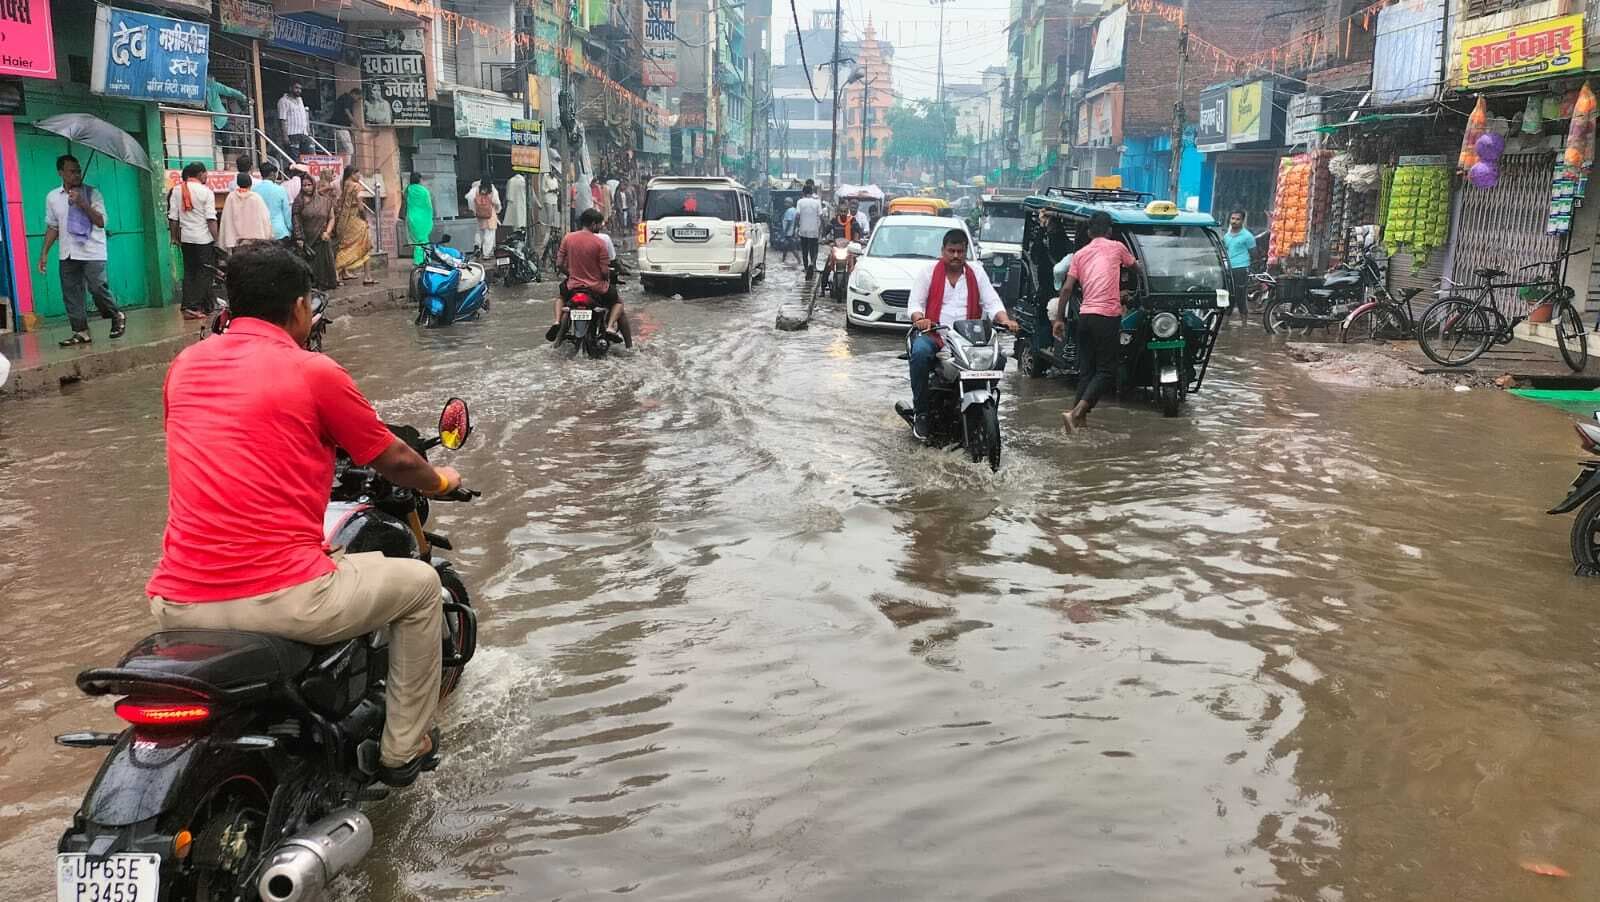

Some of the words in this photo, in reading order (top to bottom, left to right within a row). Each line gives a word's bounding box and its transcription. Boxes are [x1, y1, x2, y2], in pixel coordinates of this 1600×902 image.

[111, 21, 149, 67] देव
[1466, 25, 1574, 73] अलंकार
[2, 55, 33, 67] Haier
[169, 56, 199, 77] स्टोर
[361, 54, 424, 74] खजाना
[76, 858, 139, 880] UP65E
[76, 882, 138, 902] P3459
